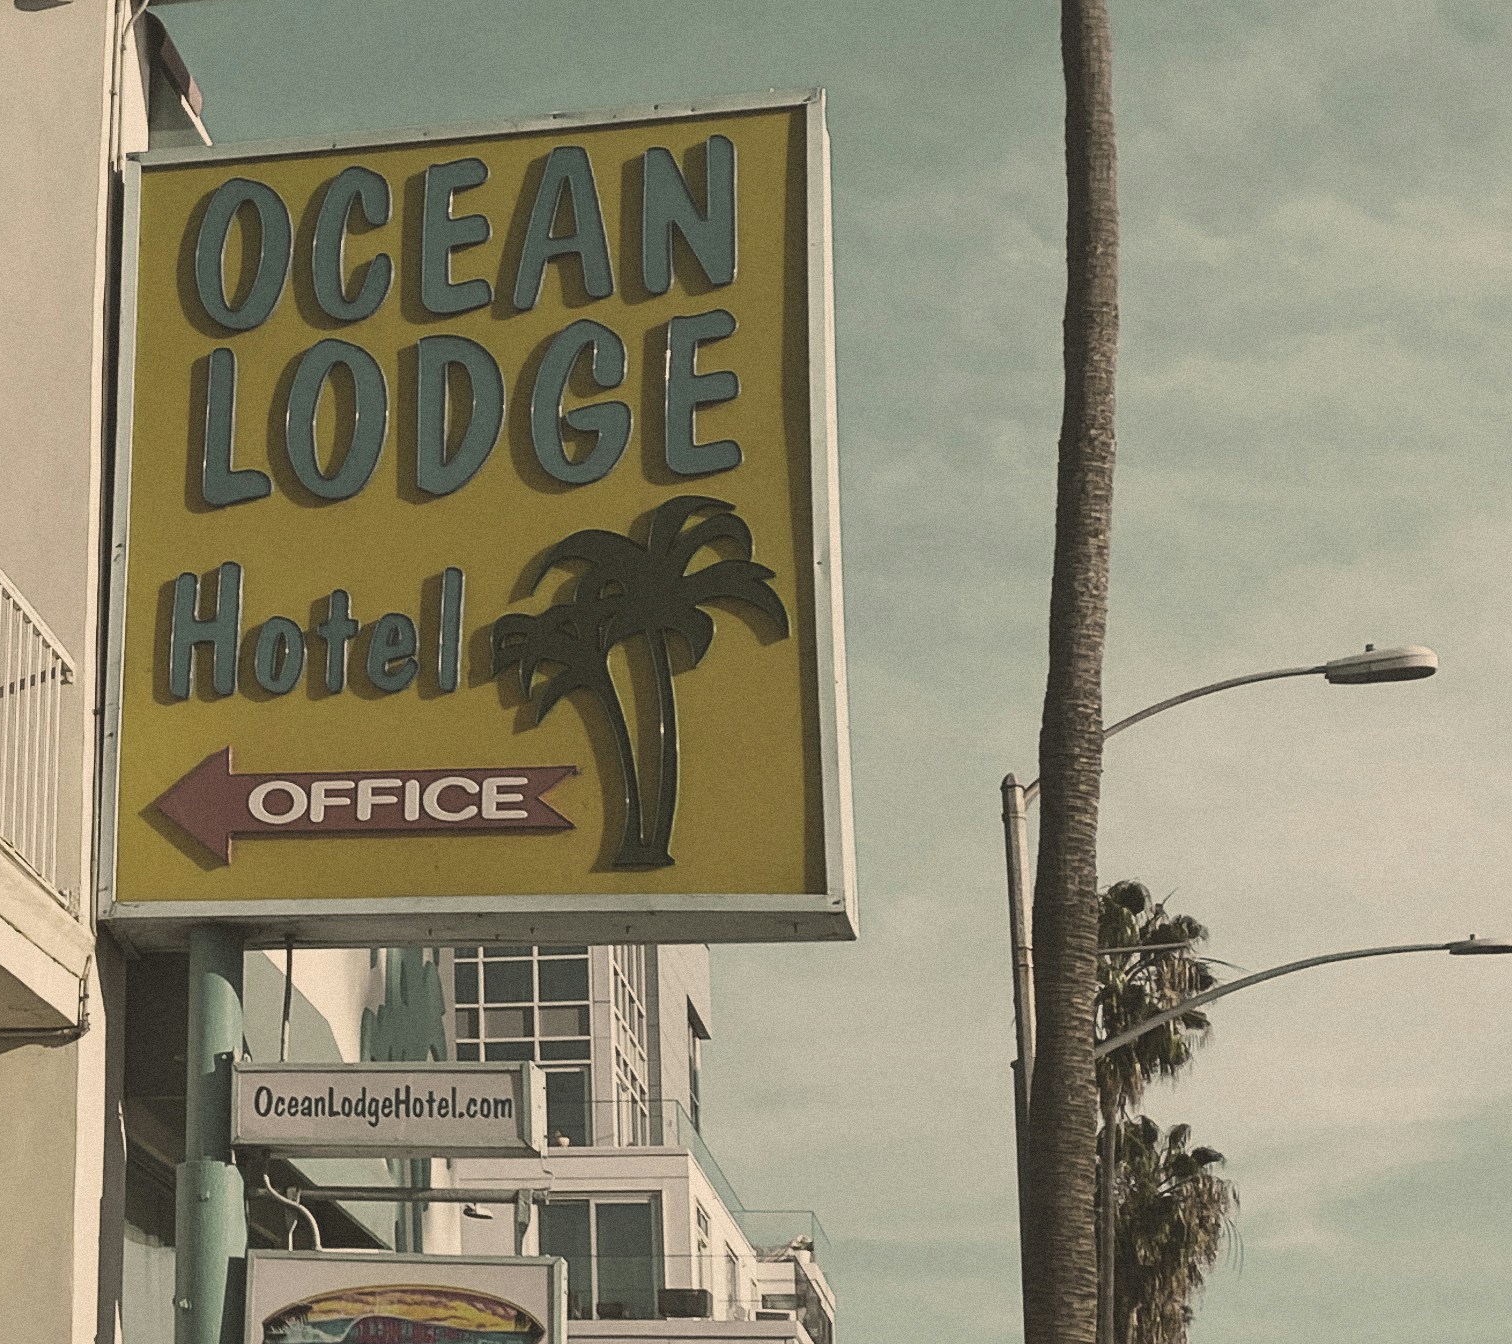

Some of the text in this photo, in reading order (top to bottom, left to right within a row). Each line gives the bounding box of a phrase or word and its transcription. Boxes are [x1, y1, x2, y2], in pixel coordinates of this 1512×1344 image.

[194, 134, 738, 331] OCEAN
[201, 308, 743, 506] LODGE
[168, 561, 466, 701] Hotel
[247, 775, 529, 825] OFFICE
[254, 1086, 513, 1127] OceanLodgeHotel.com
